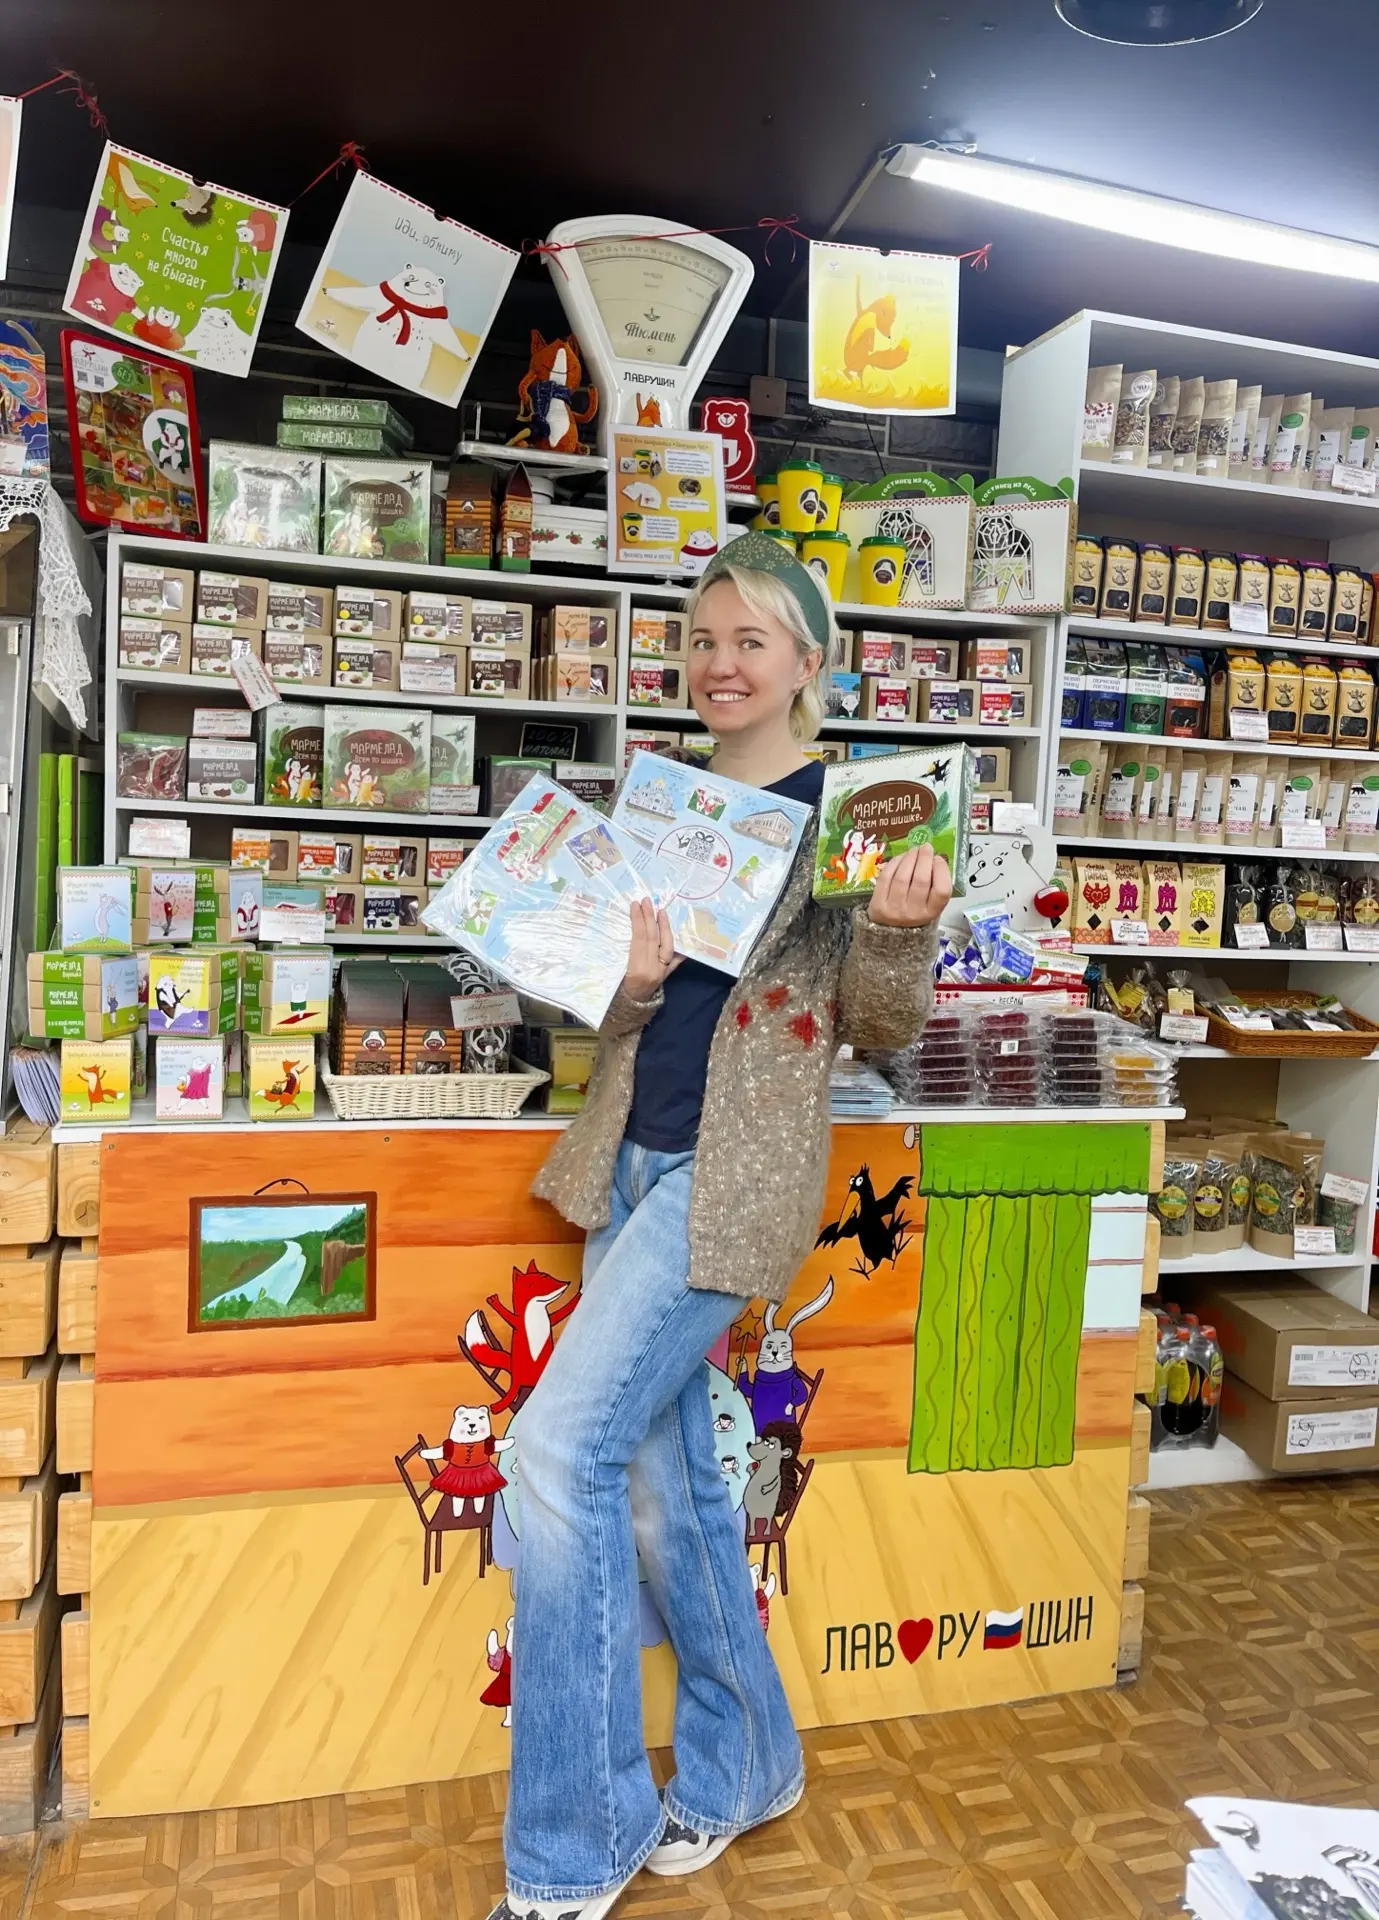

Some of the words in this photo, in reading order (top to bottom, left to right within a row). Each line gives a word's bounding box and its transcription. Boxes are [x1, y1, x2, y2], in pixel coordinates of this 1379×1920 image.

[161, 227, 209, 257] Счастья
[422, 234, 464, 266] обниму
[163, 248, 198, 271] много
[147, 257, 160, 275] не
[162, 262, 208, 291] бывает
[624, 322, 677, 344] Тюмень
[116, 366, 132, 383] БЕЗ
[624, 371, 675, 388] ЛАВРУШИН
[308, 403, 360, 420] МАРМЕЛАД
[302, 430, 354, 446] МАРМЕЛАД
[725, 483, 752, 491] ЕРМСКОЕ
[881, 478, 912, 497] ГОСТИНЕЦ
[922, 479, 937, 493] ЛЕСА
[982, 483, 1012, 502] ГОСТИНЕЦ
[1022, 482, 1037, 497] ЛЕСА
[350, 492, 403, 508] МАРМЕЛАД
[291, 739, 321, 751] МАРМЕ
[350, 742, 404, 757] МАРМЕЛАД
[523, 744, 571, 757] NATURAL
[853, 793, 922, 818] МАРМЕЛАД
[879, 818, 889, 826] по
[912, 831, 928, 844] БЕЗ
[46, 961, 82, 973] МАРМЕЛАД
[49, 991, 78, 1001] МАРМЕЛАД
[999, 997, 1024, 1006] ВЕСЁЛЫ
[821, 1622, 895, 1674] ЛАВ
[937, 1610, 981, 1660] РУ
[1025, 1595, 1094, 1649] ШИН
